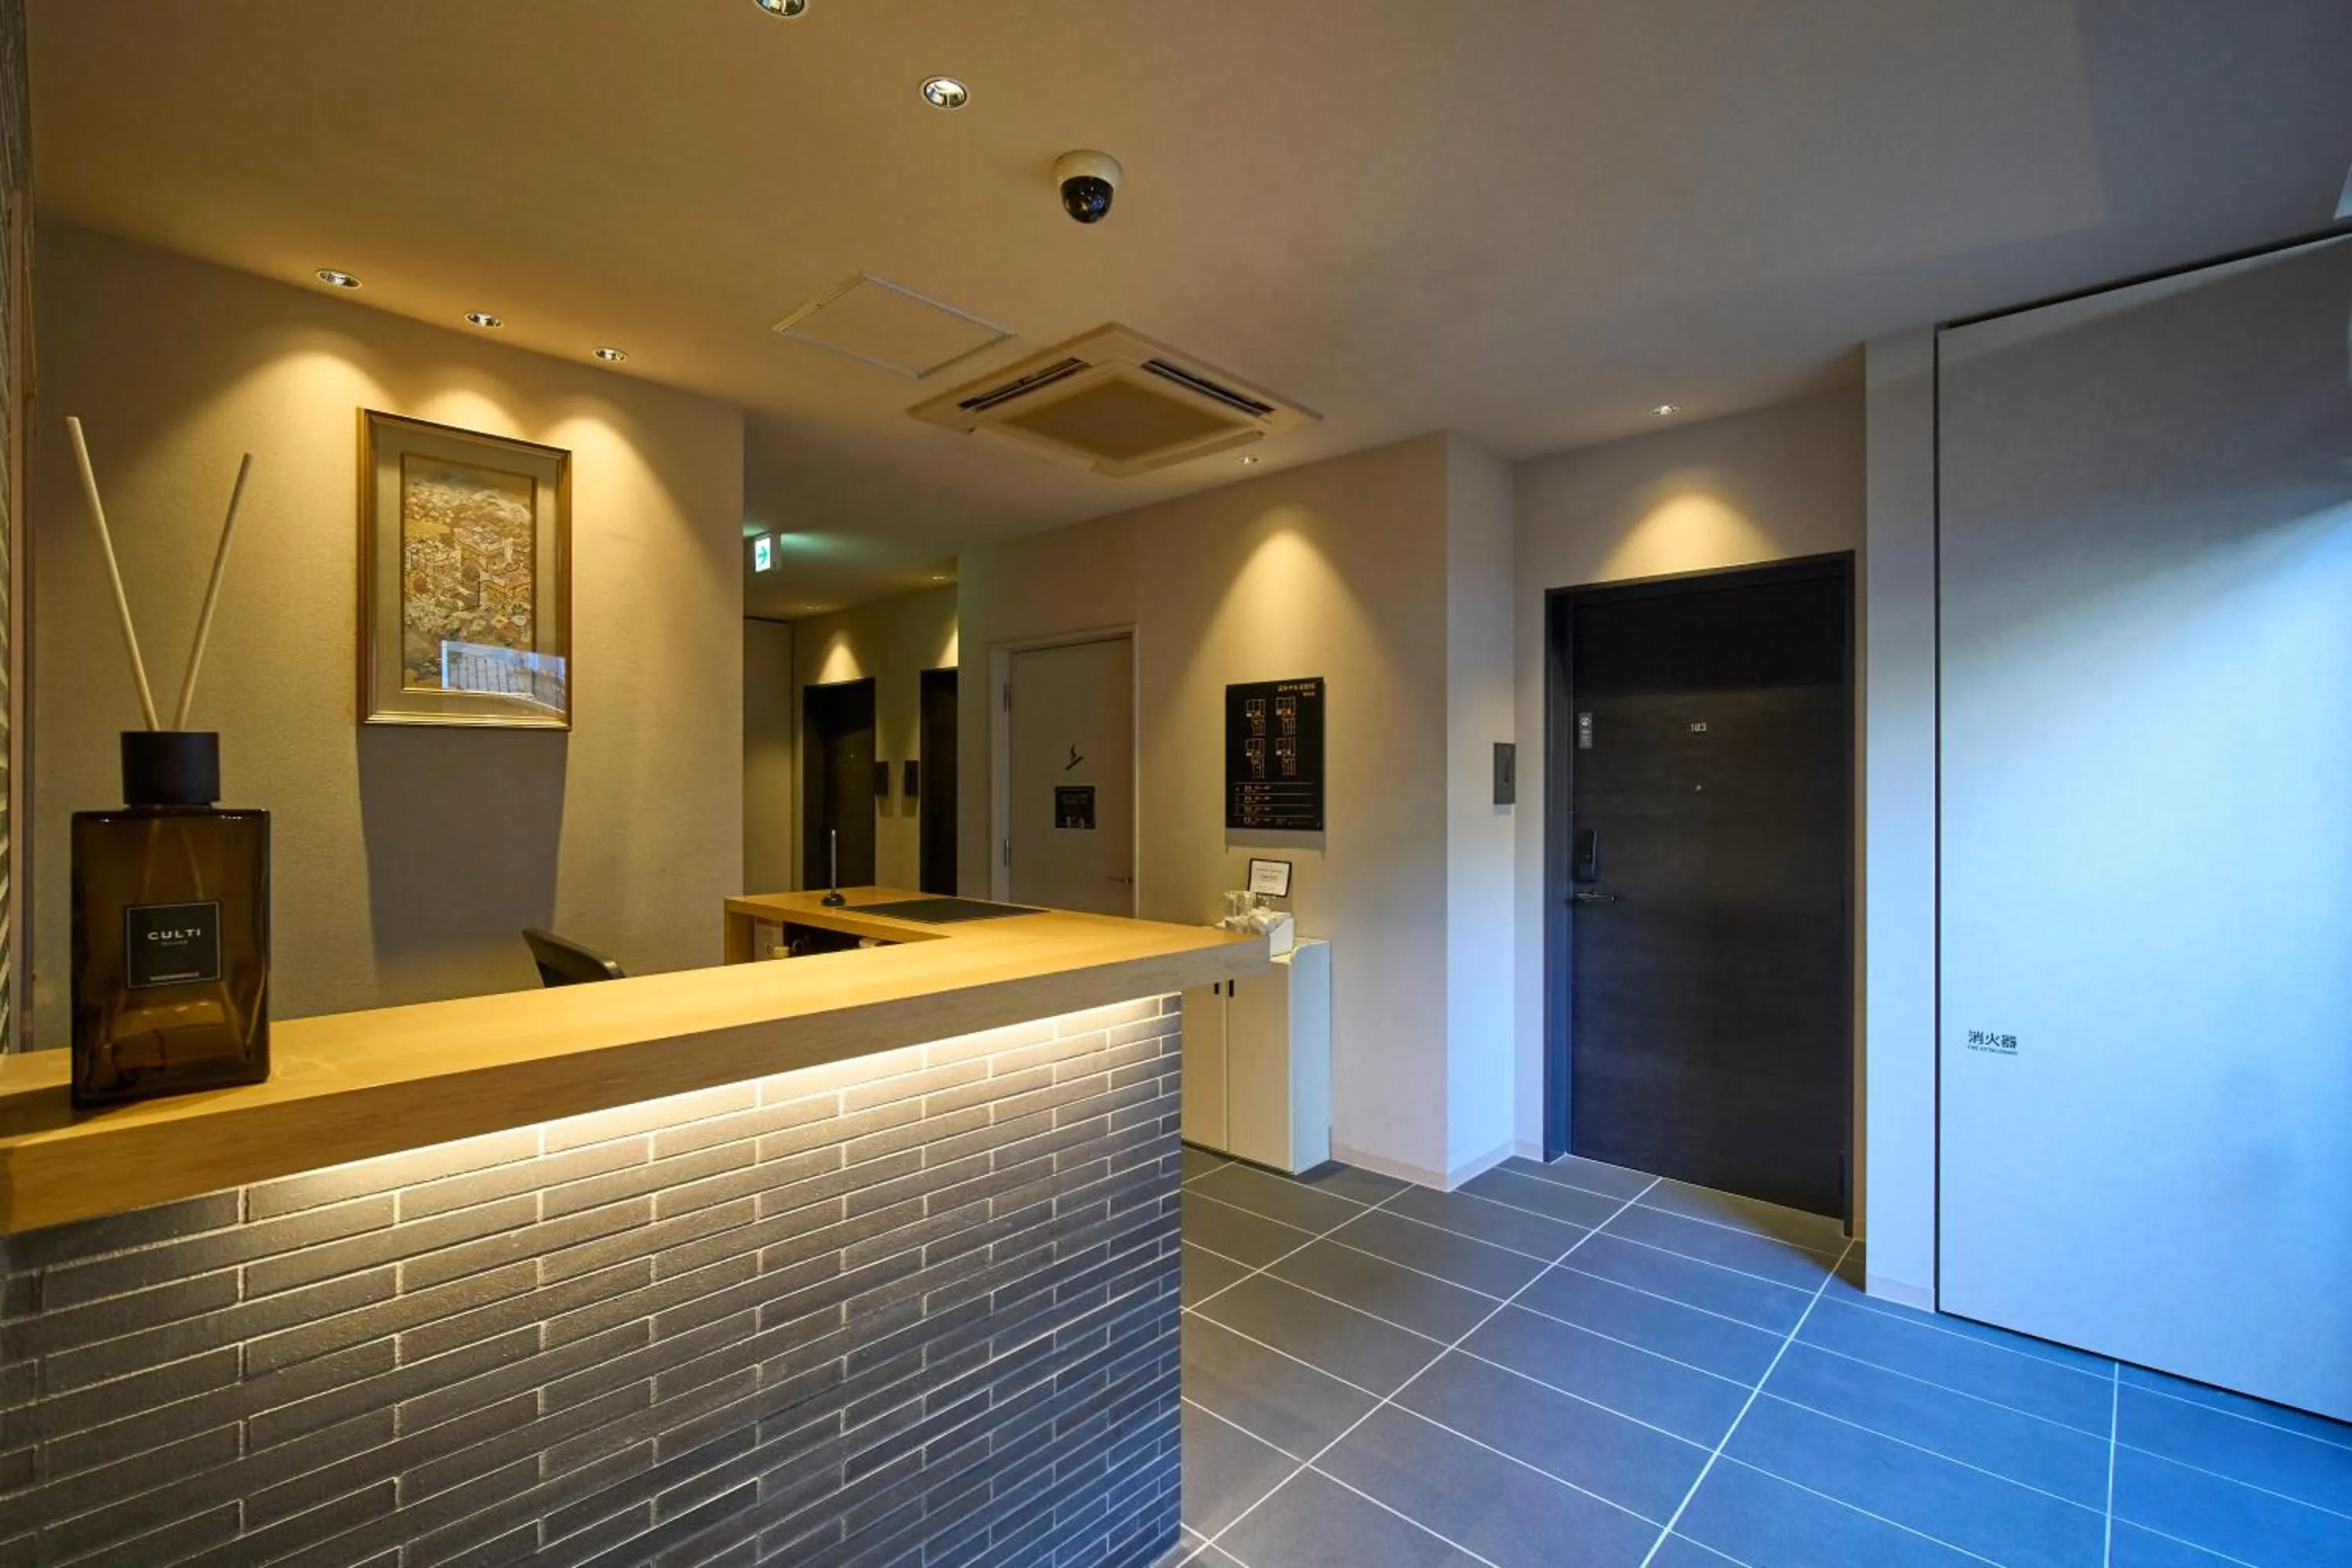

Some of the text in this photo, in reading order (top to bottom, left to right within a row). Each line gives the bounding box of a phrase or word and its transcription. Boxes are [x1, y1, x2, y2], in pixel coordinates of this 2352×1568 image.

[1690, 722, 1707, 732] 103
[148, 928, 200, 940] CULTI
[1969, 1030, 2017, 1048] 消火器
